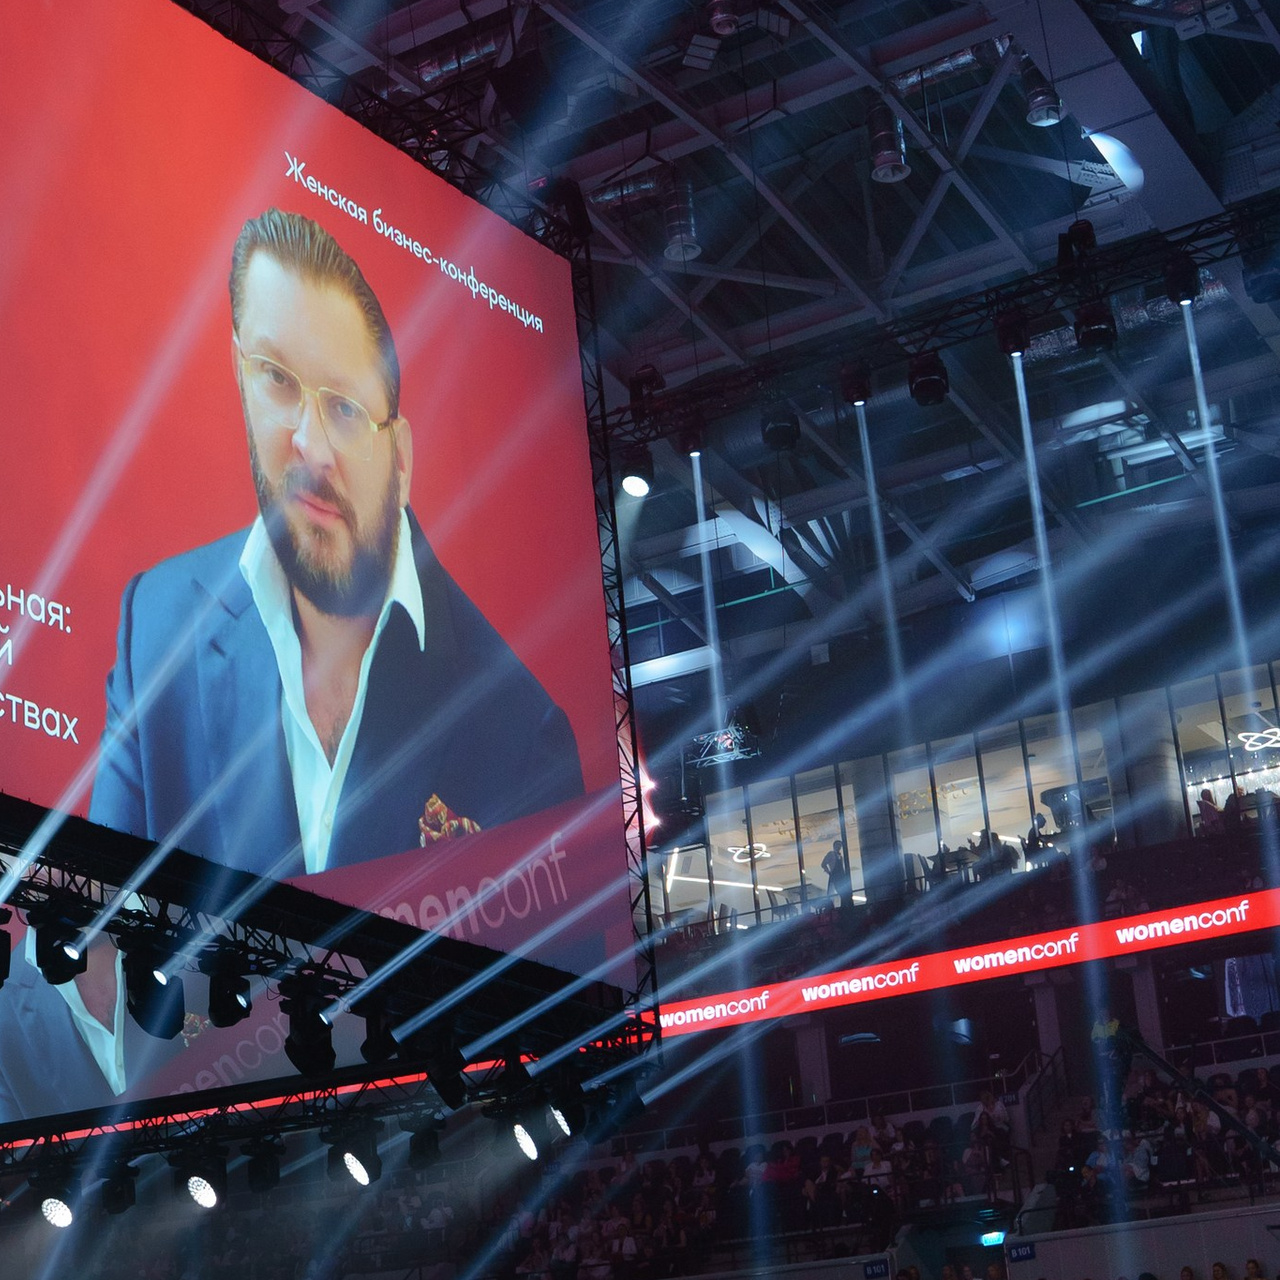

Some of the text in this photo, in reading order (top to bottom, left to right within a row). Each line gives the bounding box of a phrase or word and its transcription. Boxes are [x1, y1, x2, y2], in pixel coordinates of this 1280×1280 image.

[284, 151, 544, 334] Женская бизнес-конференция
[1116, 900, 1250, 944] womenconf
[953, 932, 1080, 974] womenconf
[801, 962, 920, 1002] womenconf
[659, 990, 770, 1028] womenconf
[1019, 1246, 1032, 1257] 101
